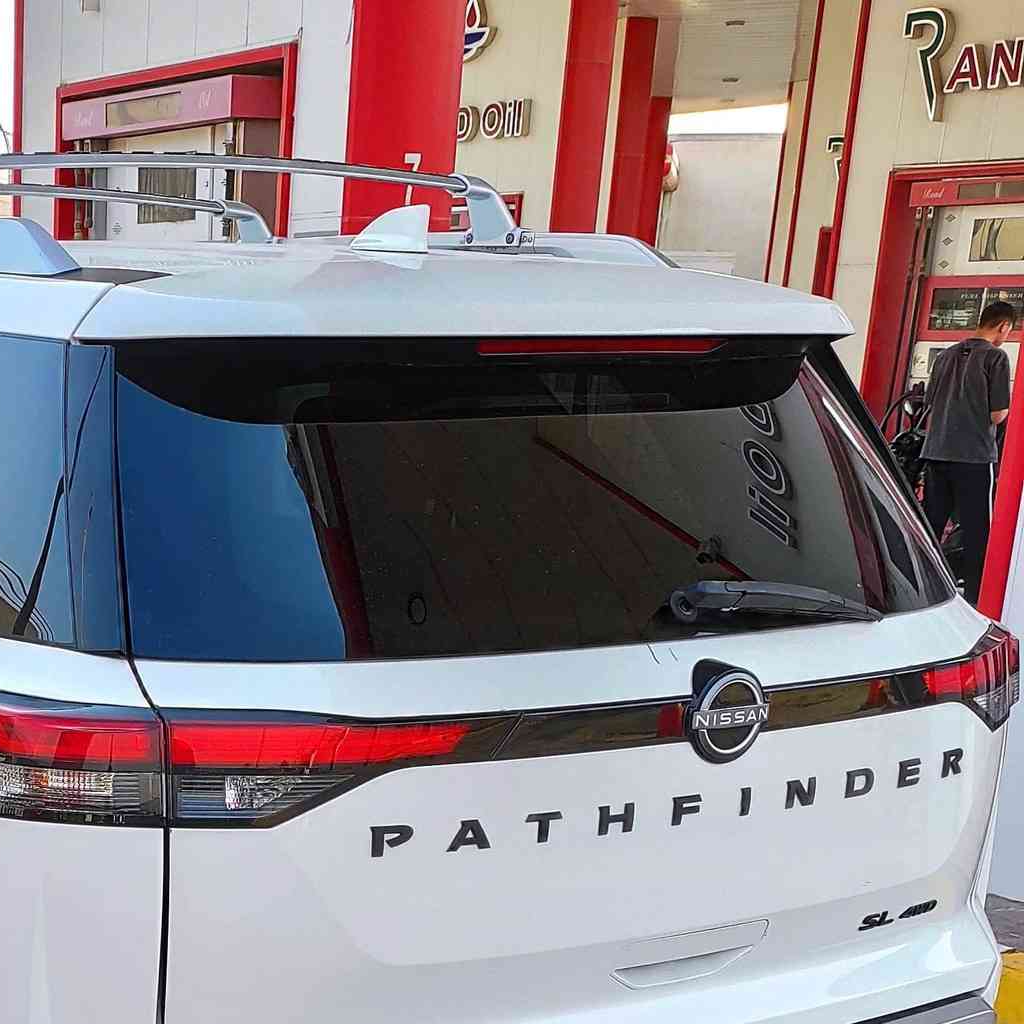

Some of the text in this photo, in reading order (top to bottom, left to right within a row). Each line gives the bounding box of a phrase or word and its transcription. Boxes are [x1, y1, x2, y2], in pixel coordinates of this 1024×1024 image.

[480, 98, 528, 139] Oil
[695, 707, 768, 728] NISSAN
[370, 748, 965, 858] PATHFINDER
[858, 910, 895, 931] SL
